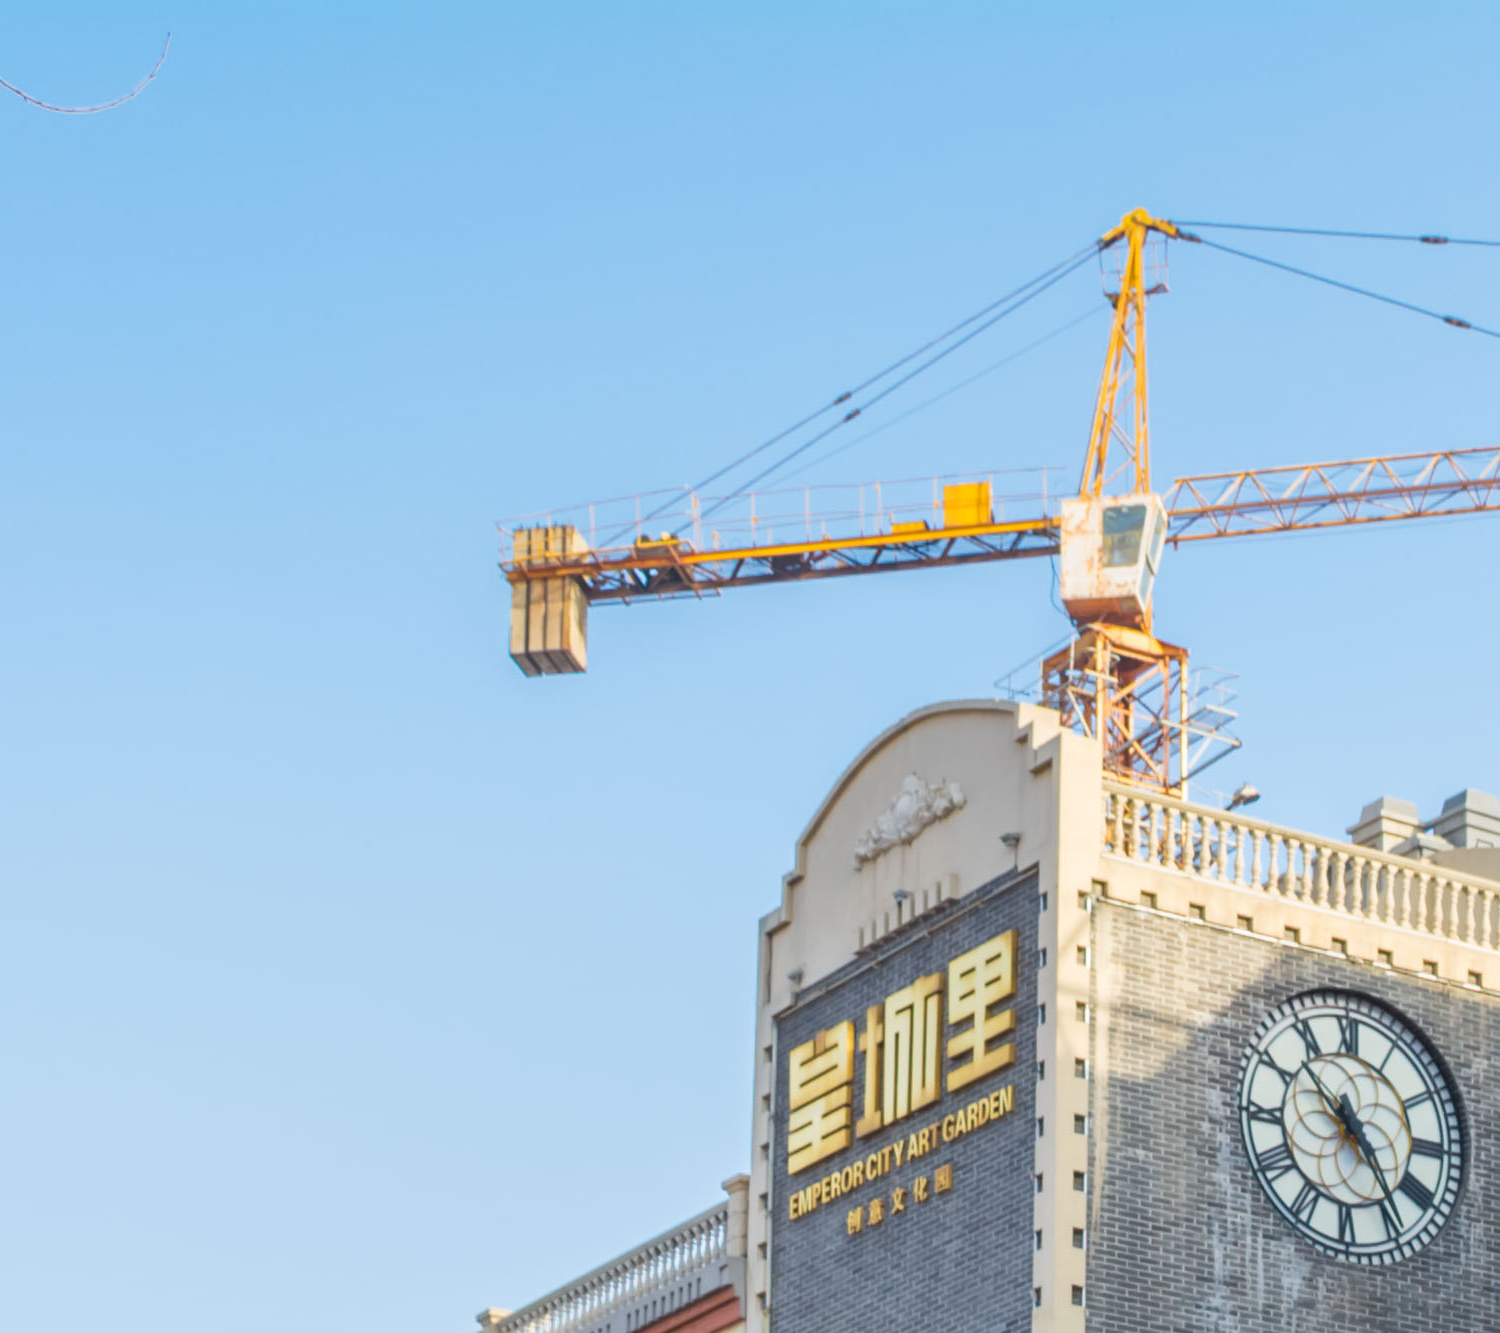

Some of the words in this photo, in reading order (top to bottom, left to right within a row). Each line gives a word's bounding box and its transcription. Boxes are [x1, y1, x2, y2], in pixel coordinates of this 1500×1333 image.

[788, 929, 1018, 1175] 皇城里
[789, 1161, 863, 1220] EMPEROR
[866, 1141, 904, 1180] CITY
[907, 1123, 941, 1161] ART
[941, 1085, 1014, 1142] GARDEN
